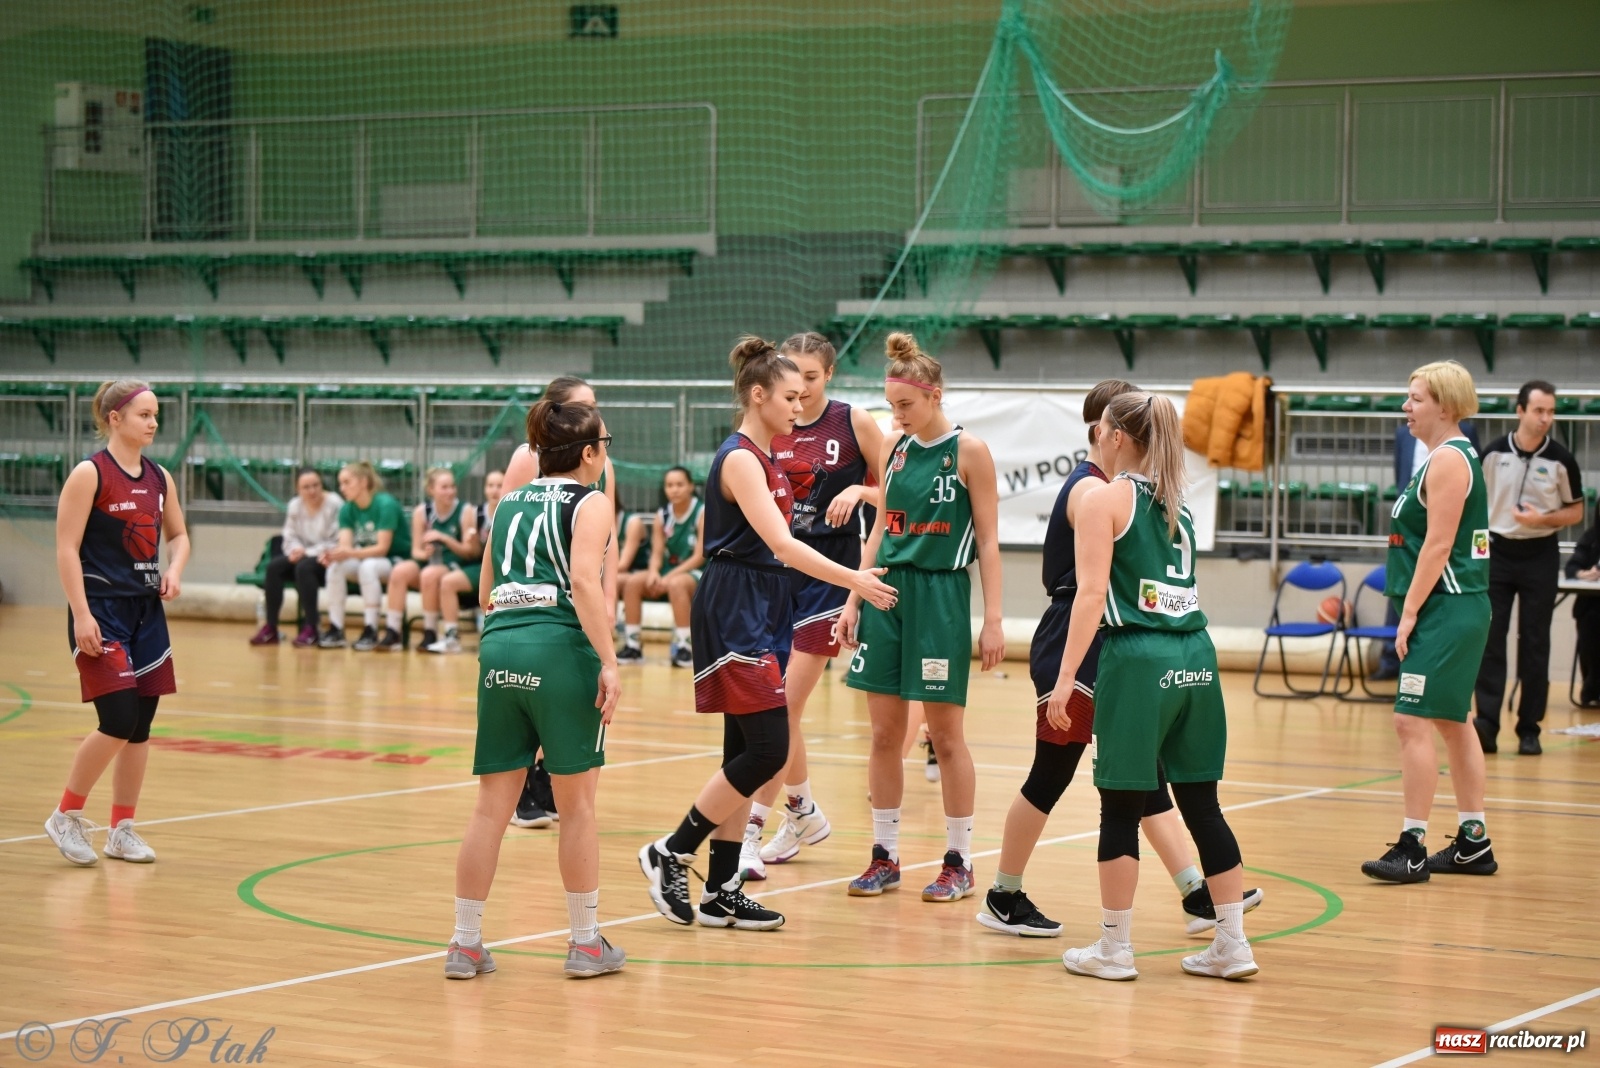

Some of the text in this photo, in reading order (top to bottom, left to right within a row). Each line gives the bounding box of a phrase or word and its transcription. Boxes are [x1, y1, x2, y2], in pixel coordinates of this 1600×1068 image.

[826, 439, 840, 466] 9
[930, 474, 957, 504] 35
[1005, 467, 1029, 492] W
[524, 488, 575, 504] RACIBÓRZ
[502, 511, 546, 578] 11
[496, 669, 542, 687] Clavis
[1174, 667, 1213, 685] Clavis
